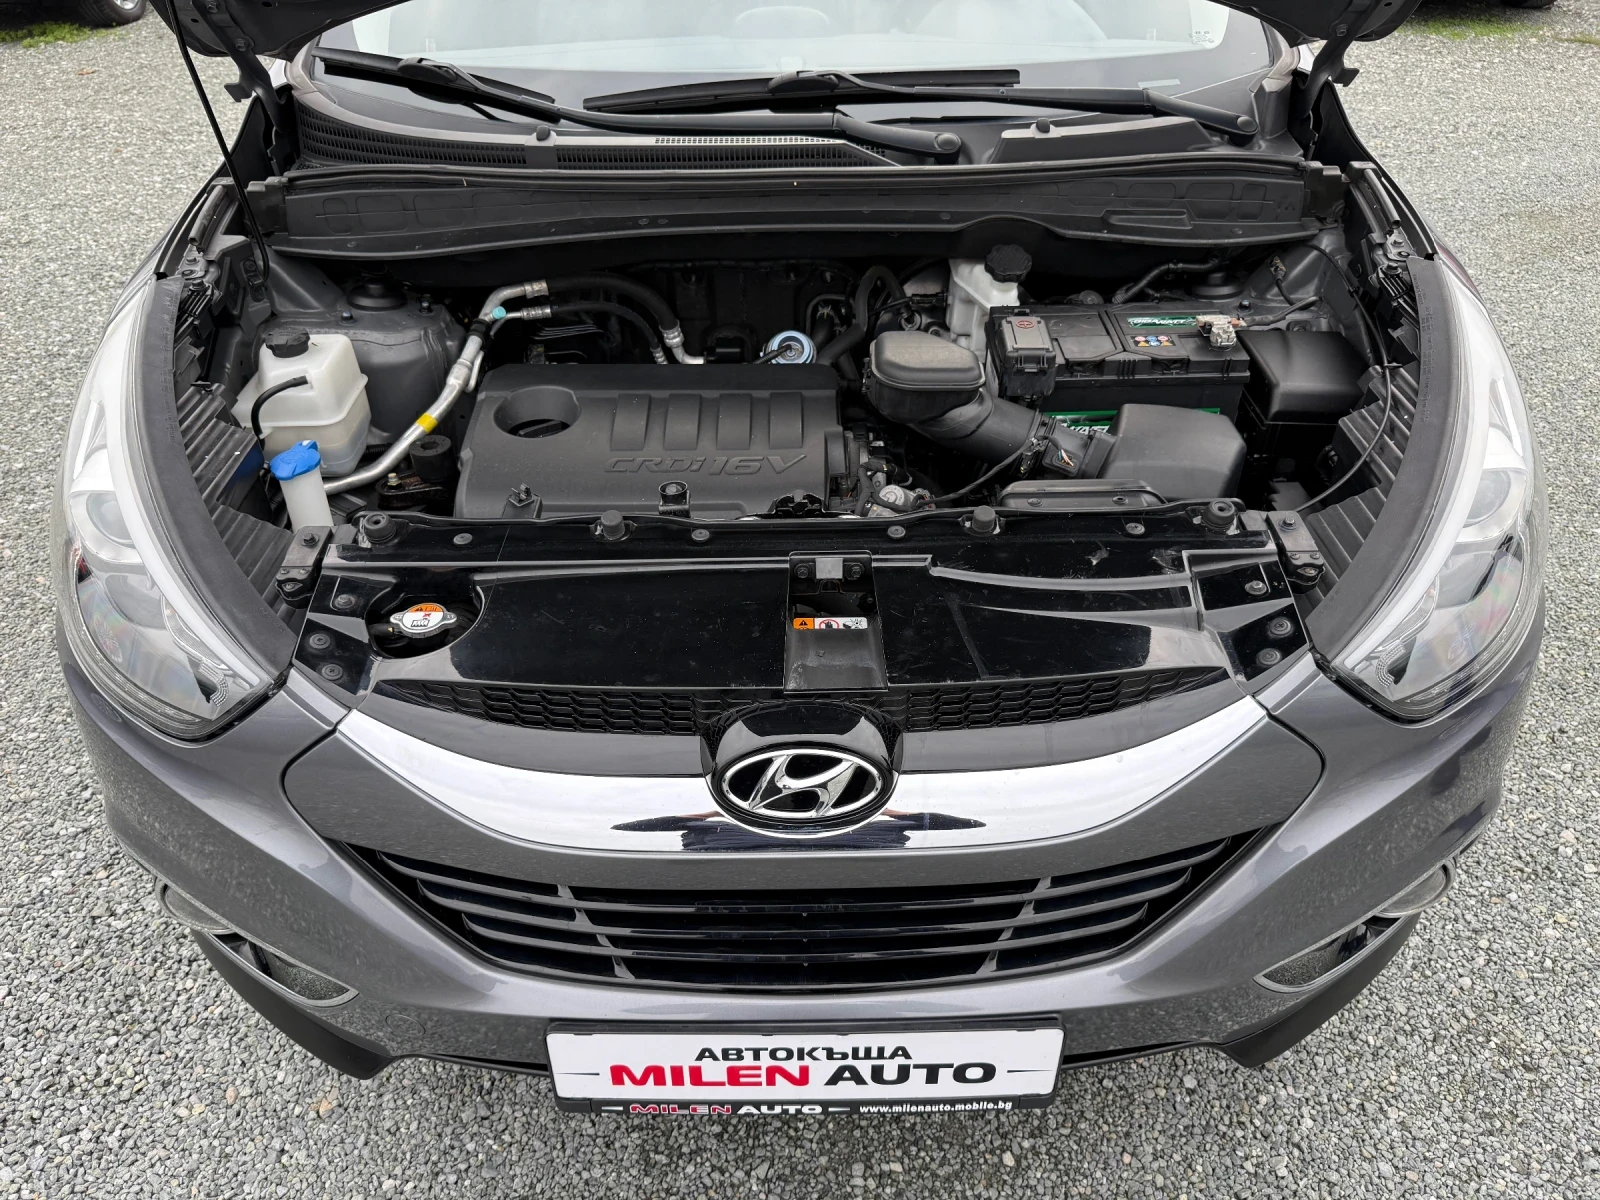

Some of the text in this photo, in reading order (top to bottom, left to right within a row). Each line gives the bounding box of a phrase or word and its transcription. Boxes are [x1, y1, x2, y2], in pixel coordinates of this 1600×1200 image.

[610, 1062, 997, 1086] MILEN AUTO
[630, 1104, 822, 1114] MILEN AUTO
[859, 1101, 1012, 1113] www.milenauto.mobile.bg
